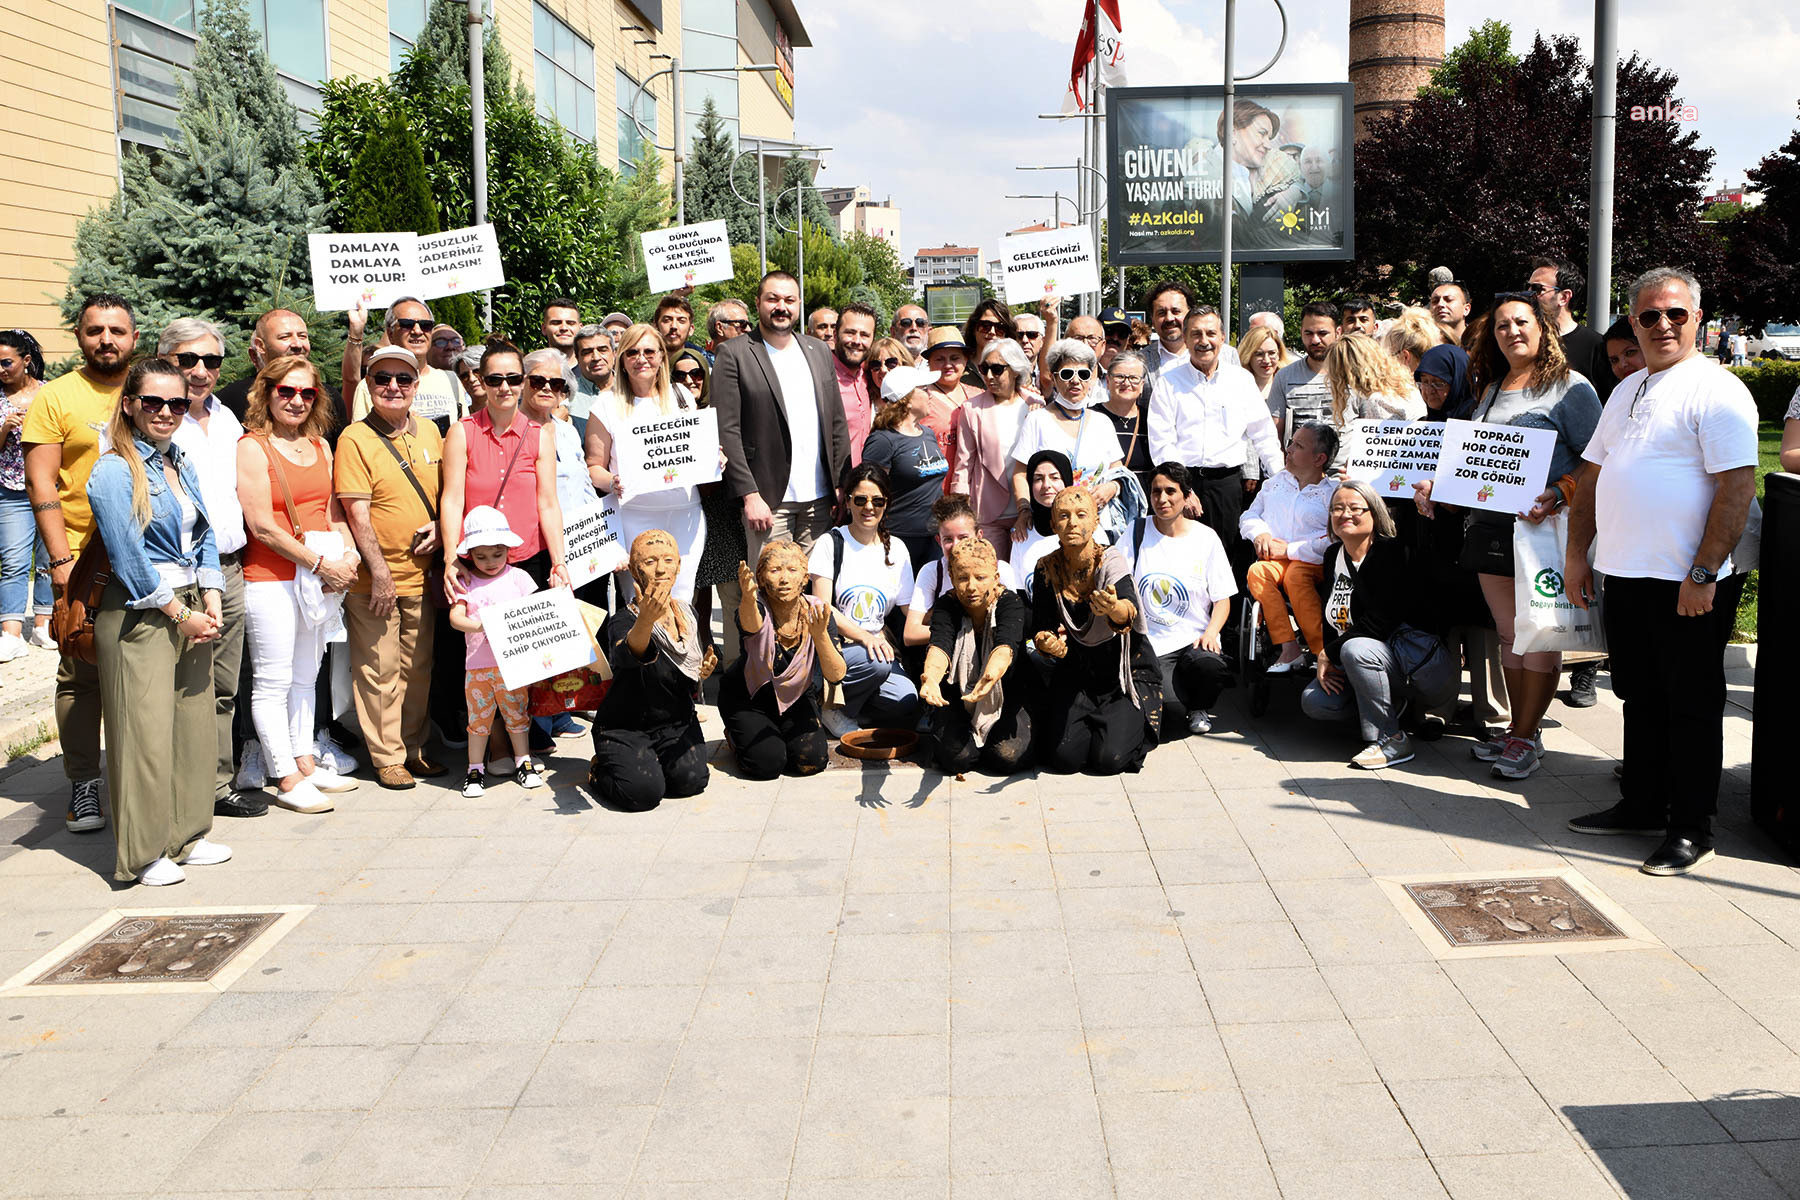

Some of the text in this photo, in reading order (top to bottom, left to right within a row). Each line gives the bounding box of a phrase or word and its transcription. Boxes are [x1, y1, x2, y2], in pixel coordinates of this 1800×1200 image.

[1124, 145, 1209, 179] GÜVENLE
[1126, 181, 1184, 206] YAŞAYAN
[1128, 210, 1204, 226] #AzKaldı
[1310, 207, 1330, 225] İYİ
[668, 230, 700, 242] DÜNYA
[329, 242, 400, 254] DAMLAYA
[648, 235, 723, 256] ÇÖL OLDUĞUNDA
[1013, 242, 1081, 262] GELECEĞİMİZİ
[666, 246, 709, 262] SEN YEŞİL
[331, 257, 401, 269] DAMLAYA
[421, 257, 482, 276] OLMASIN!
[662, 256, 715, 271] KALMAZSIN!
[1007, 254, 1089, 273] KURUTMAYALIM!
[329, 272, 406, 285] YOK OLUR!
[632, 417, 700, 435] GELECEĞİNE
[1361, 425, 1445, 437] GEL SEN DOĞAY
[643, 431, 691, 446] MİRASIN
[1365, 435, 1416, 447] GÖNLÜNÜ
[1473, 429, 1524, 444] TOPRAĞI
[647, 444, 690, 459] ÇÖLLER
[1366, 449, 1440, 460] O HER ZAMAN
[1462, 442, 1530, 459] HOR GÖREN
[643, 455, 697, 471] OLMASIN.
[1351, 458, 1414, 471] KARŞILIĞINI
[1465, 456, 1521, 471] GELECEĞİ
[1454, 468, 1526, 486] ZOR GÖRÜR!
[563, 507, 616, 536] oprağını koru,
[568, 520, 609, 549] geleceğini
[503, 600, 556, 620] AĞACIMIZA,
[507, 611, 559, 632] İKLİMİMİZE,
[506, 620, 568, 644] TOPRAĞIMIZA
[502, 629, 581, 659] SAHİP ÇIKIYORUZ.
